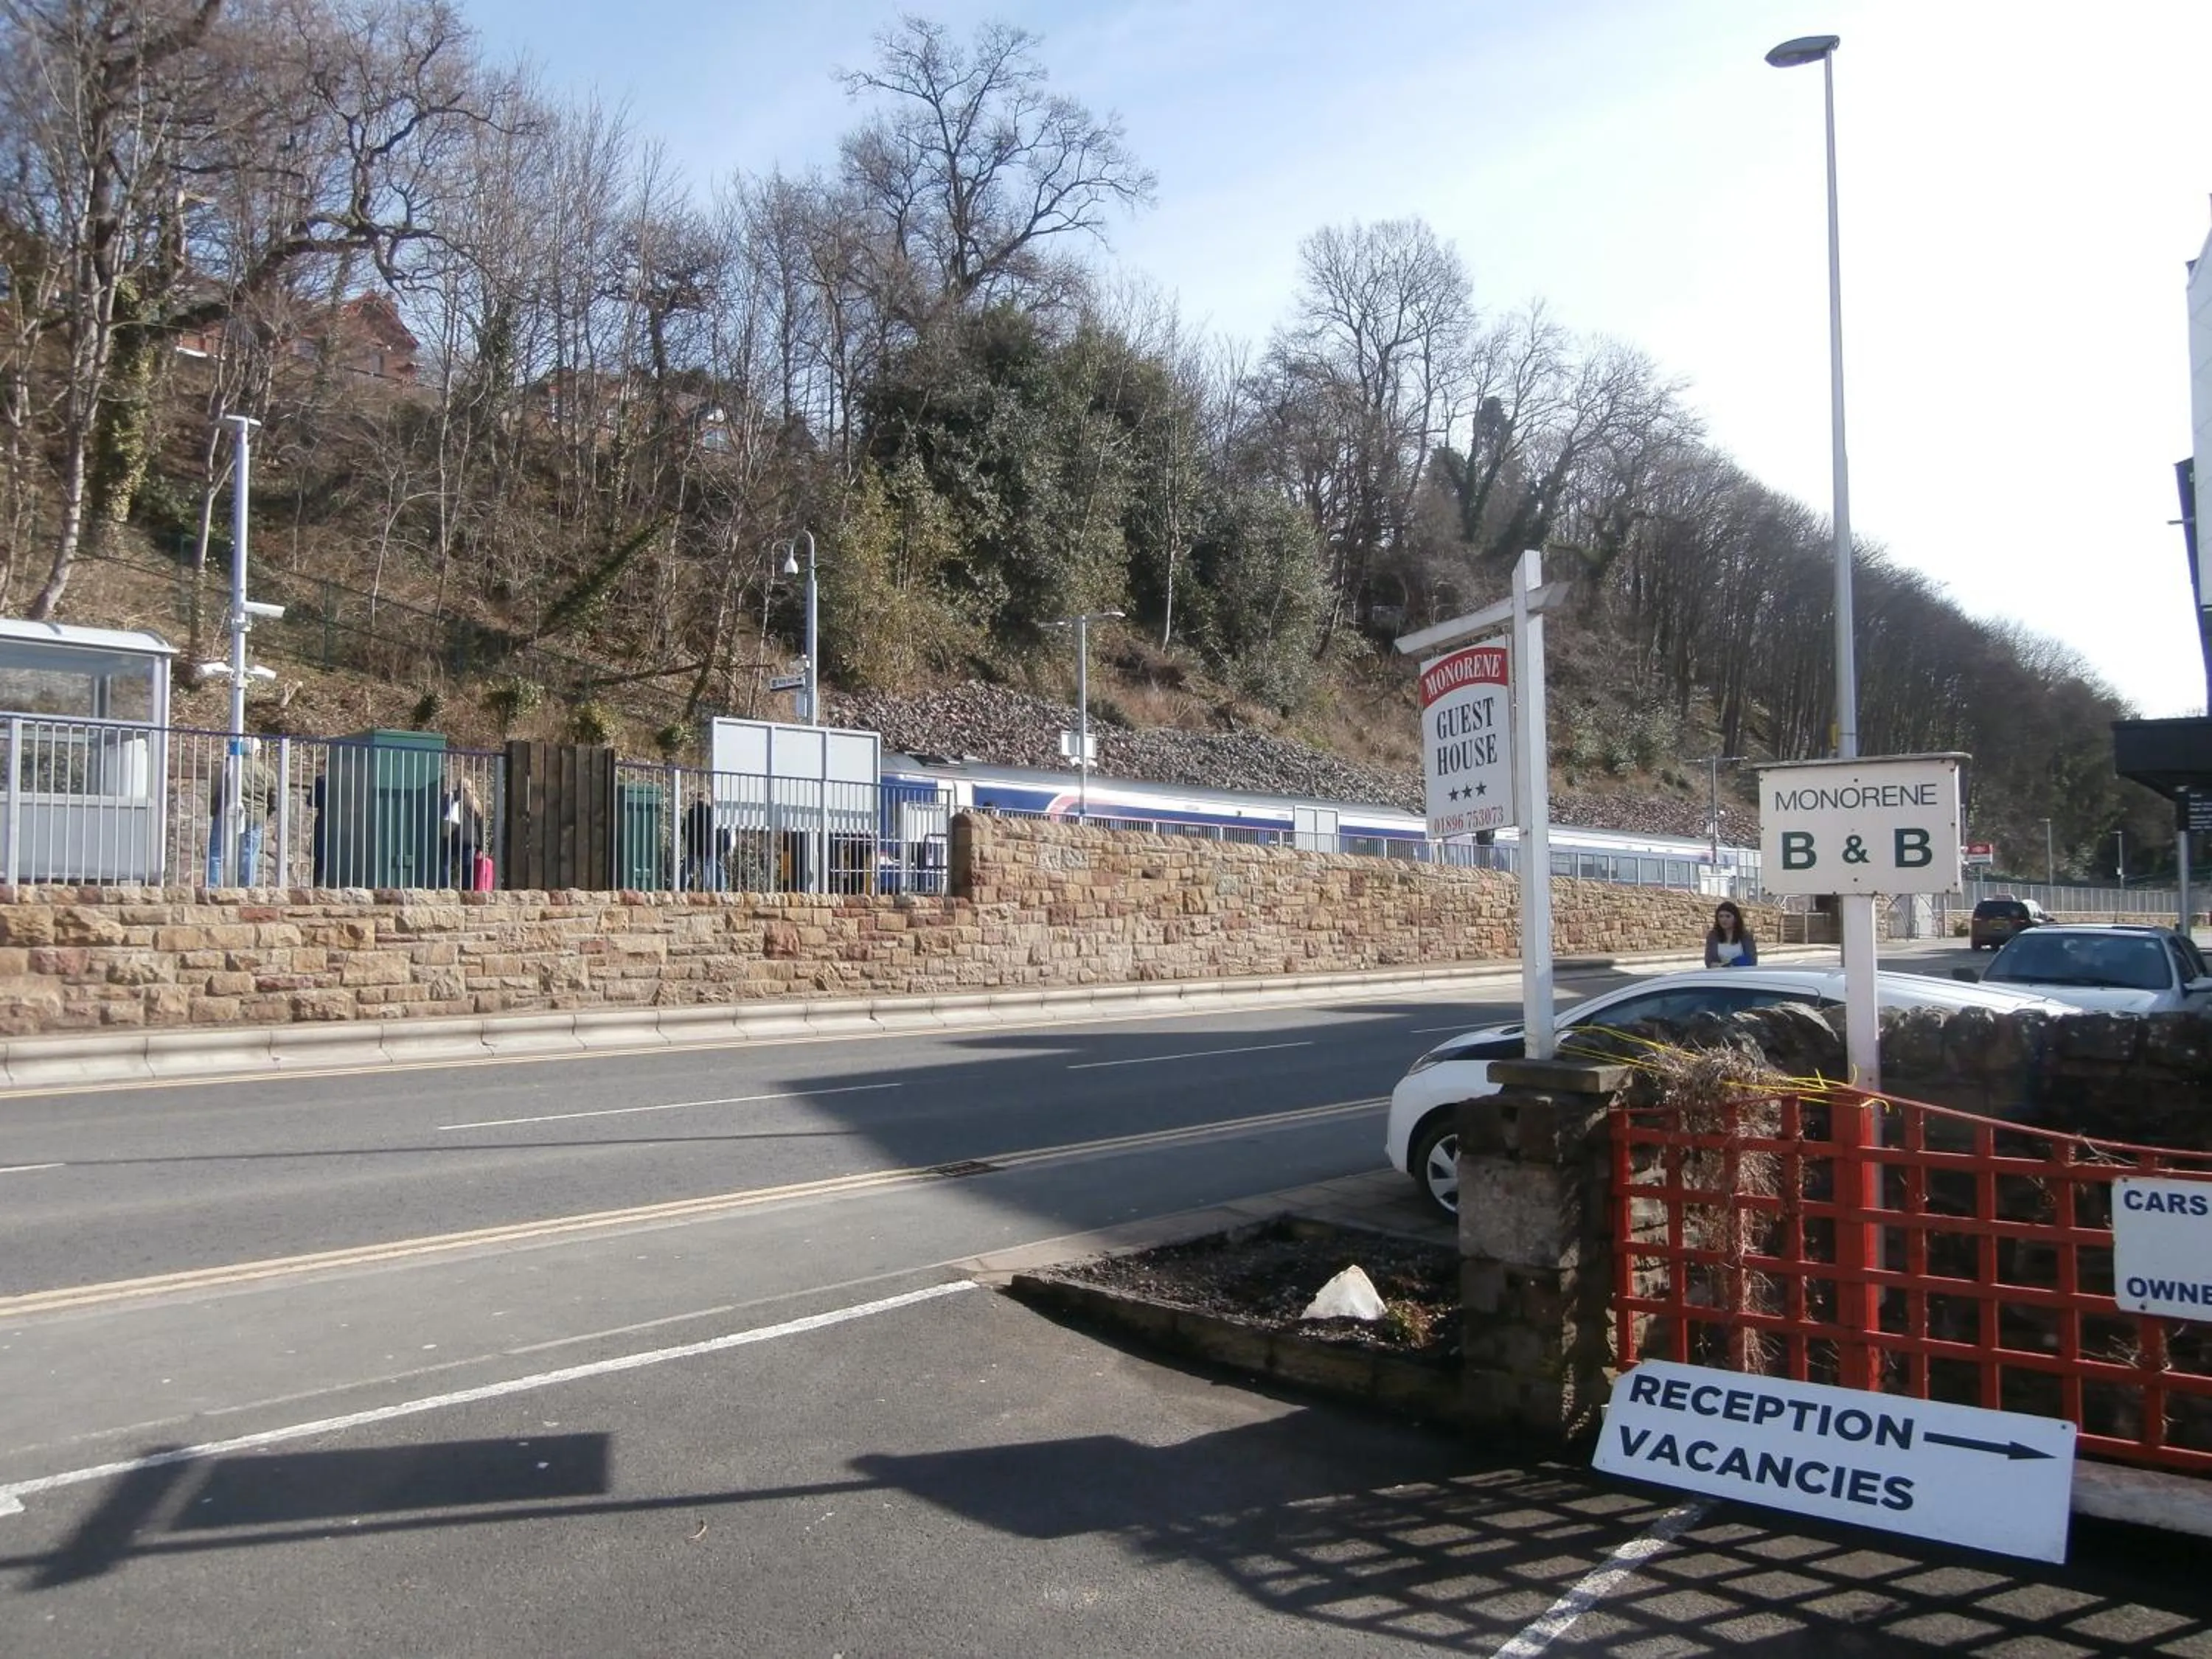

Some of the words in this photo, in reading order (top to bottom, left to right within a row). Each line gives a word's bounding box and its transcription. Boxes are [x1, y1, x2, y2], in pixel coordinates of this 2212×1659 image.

[1425, 653, 1502, 699] MONORENE
[1436, 697, 1495, 740] GUEST
[1437, 734, 1498, 776] HOUSE
[1775, 783, 1938, 812] MONORENE
[1433, 813, 1464, 833] 01896
[1781, 831, 1818, 871] B
[1842, 835, 1871, 863] &
[1893, 828, 1933, 868] B
[2123, 1189, 2209, 1216] CARS
[1628, 1374, 1915, 1450] RECEPTION
[1620, 1425, 1915, 1512] VACANCIES
